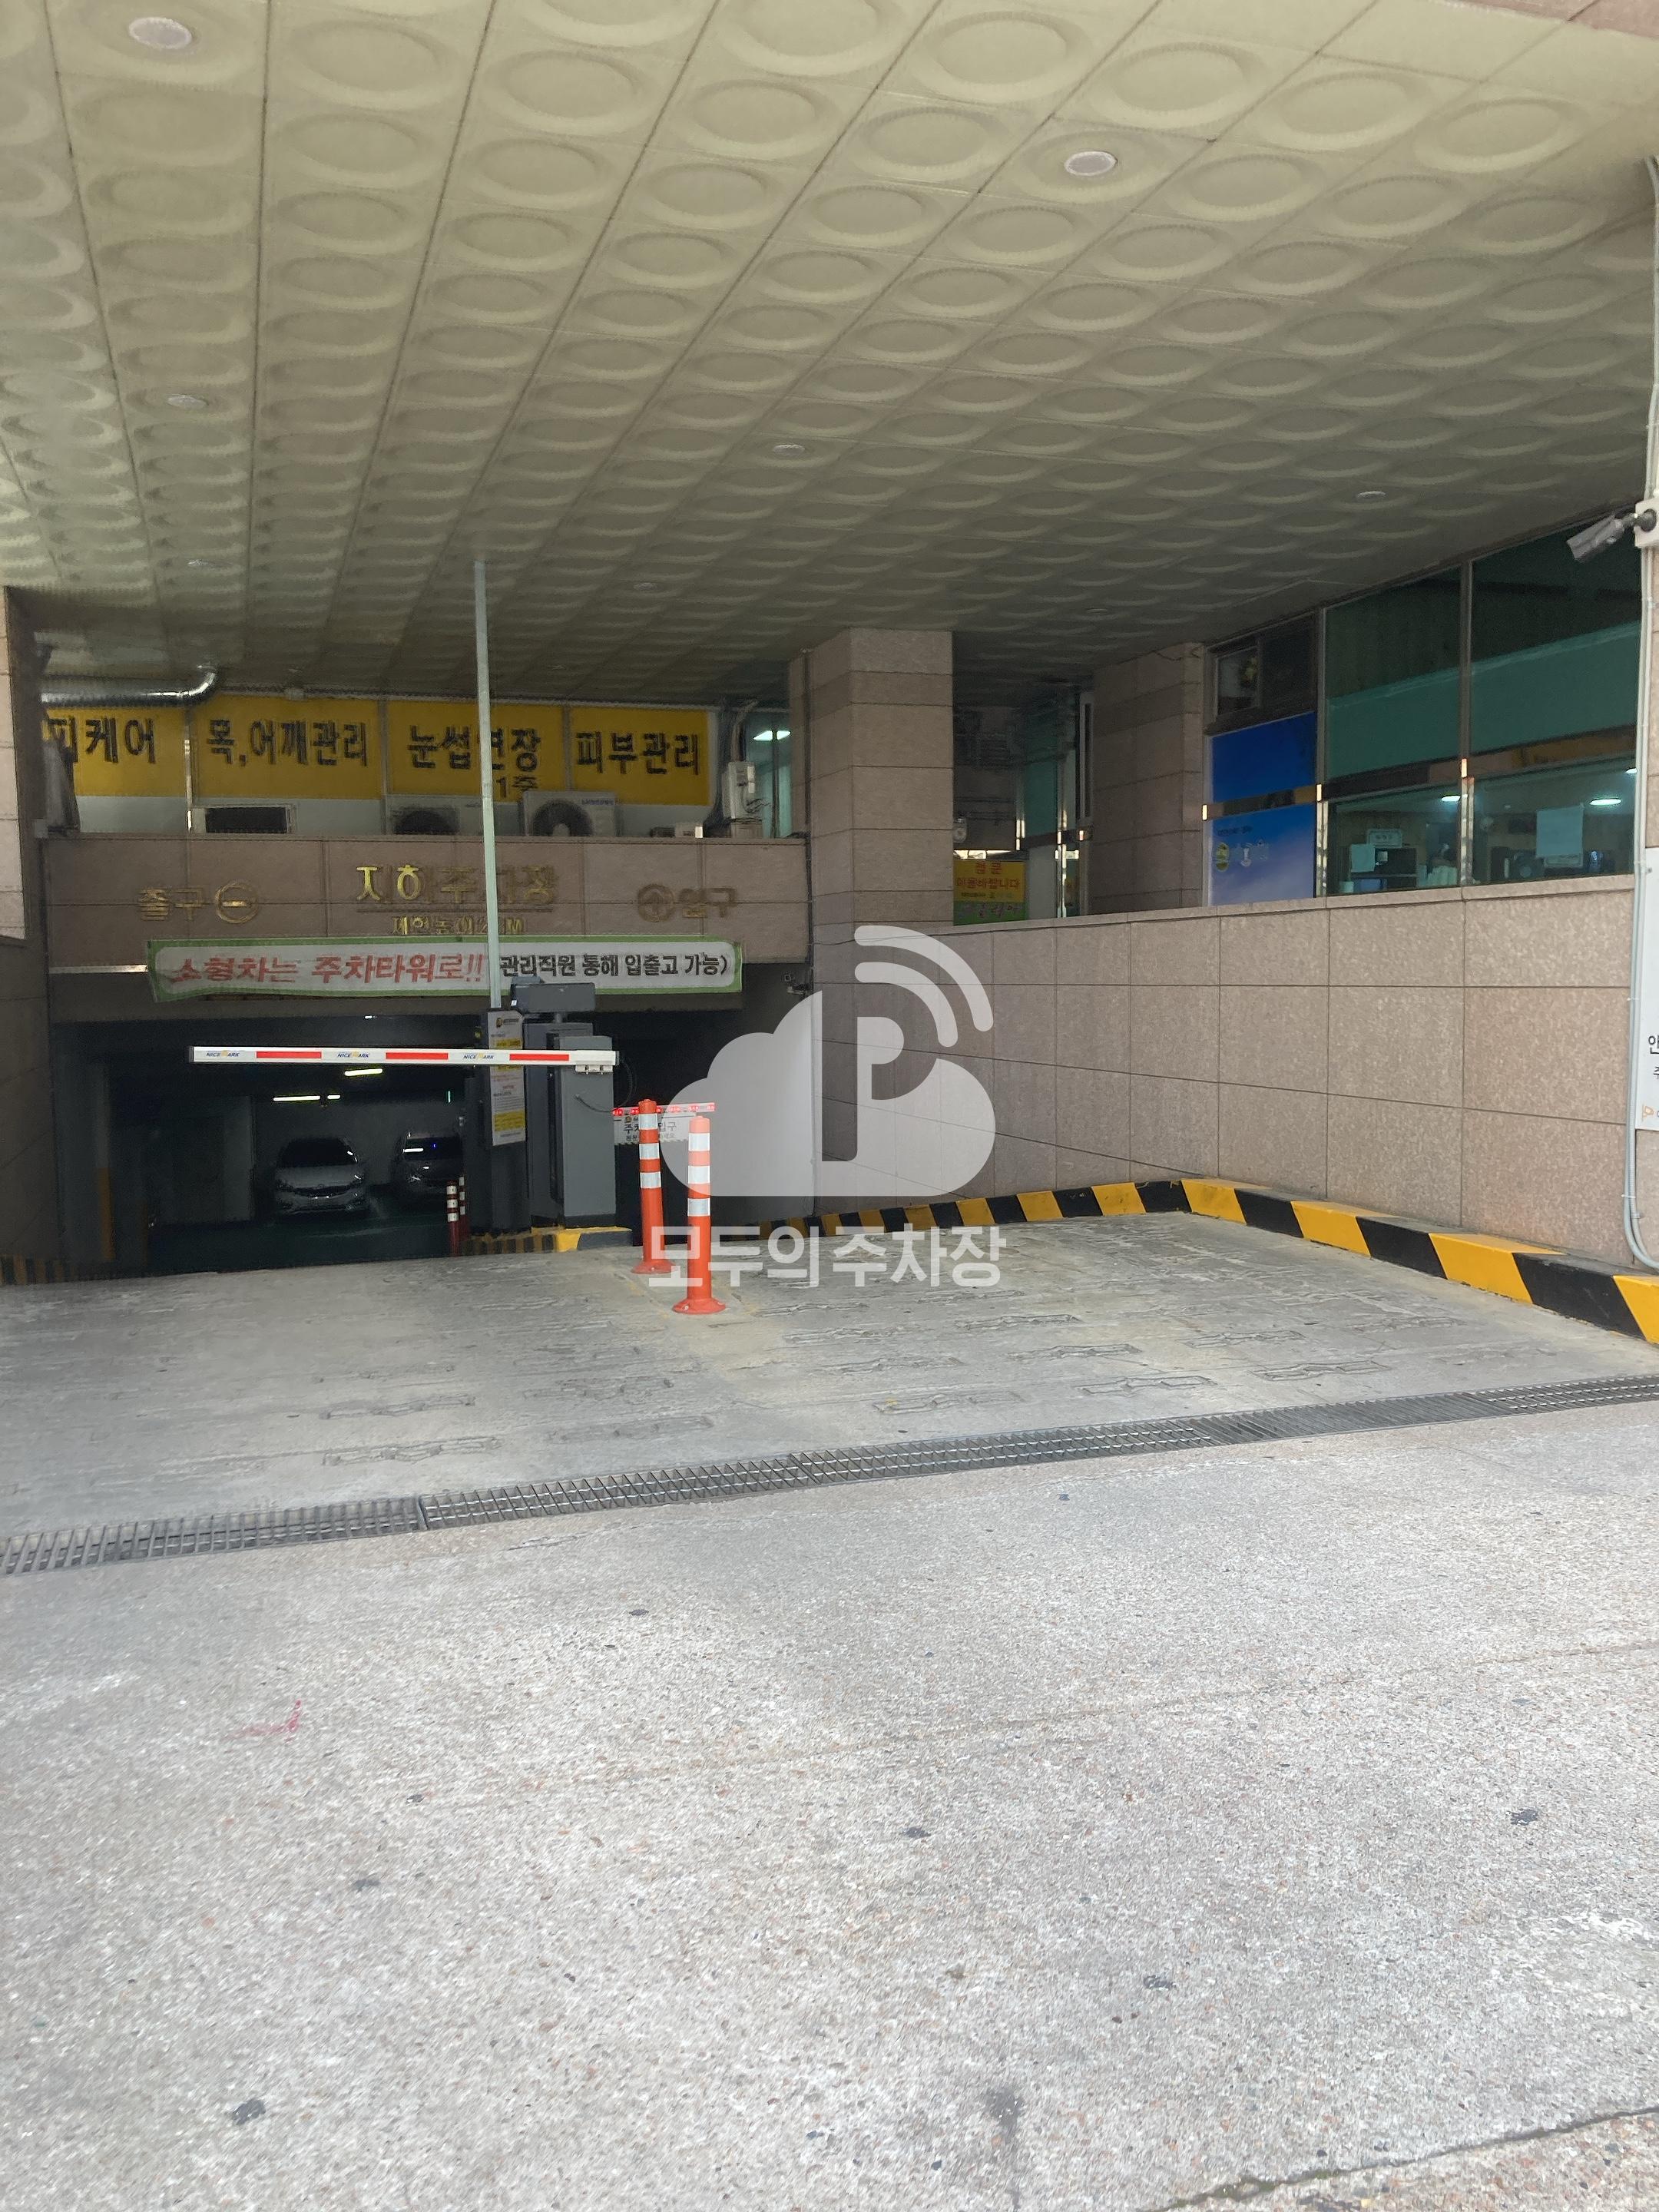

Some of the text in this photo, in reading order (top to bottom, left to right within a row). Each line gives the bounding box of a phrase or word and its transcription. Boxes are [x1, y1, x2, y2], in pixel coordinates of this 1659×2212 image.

[207, 717, 367, 767] 목,어깨관리
[577, 730, 699, 776] 피부관리
[138, 888, 204, 921] 출구
[168, 951, 728, 984] 소형차는 주차타워로!! 관리직원 통해 입출고 가능)
